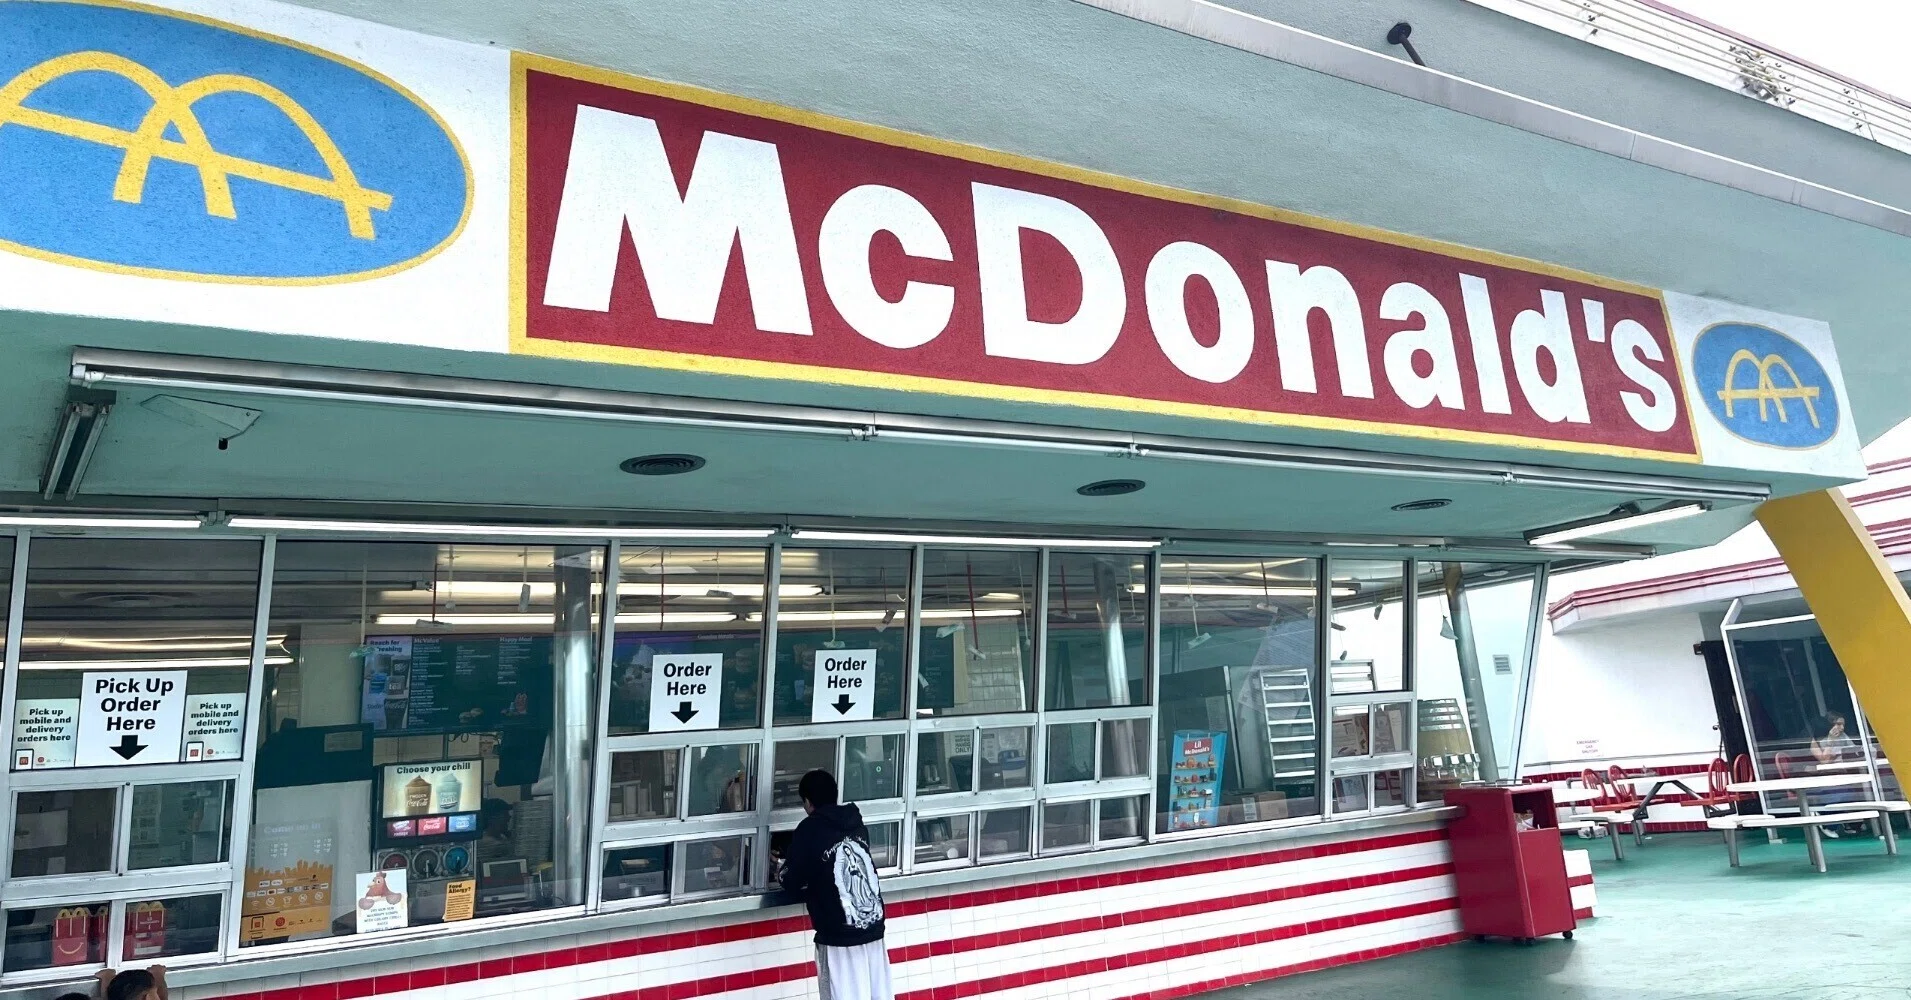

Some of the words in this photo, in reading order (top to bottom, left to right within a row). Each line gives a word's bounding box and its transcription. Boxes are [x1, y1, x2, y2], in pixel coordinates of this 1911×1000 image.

[543, 103, 1675, 432] McDonald's
[663, 662, 712, 677] Order
[824, 657, 867, 671] Order
[96, 678, 140, 694] Pick
[146, 678, 174, 696] Up
[667, 681, 707, 696] Here
[827, 675, 863, 688] Here
[101, 696, 161, 712] Order
[199, 702, 219, 710] Pick
[25, 726, 65, 734] delivery
[106, 716, 156, 731] Here
[196, 719, 232, 727] delivery
[397, 766, 430, 774] Choose
[431, 765, 451, 774] your
[452, 762, 471, 771] chill
